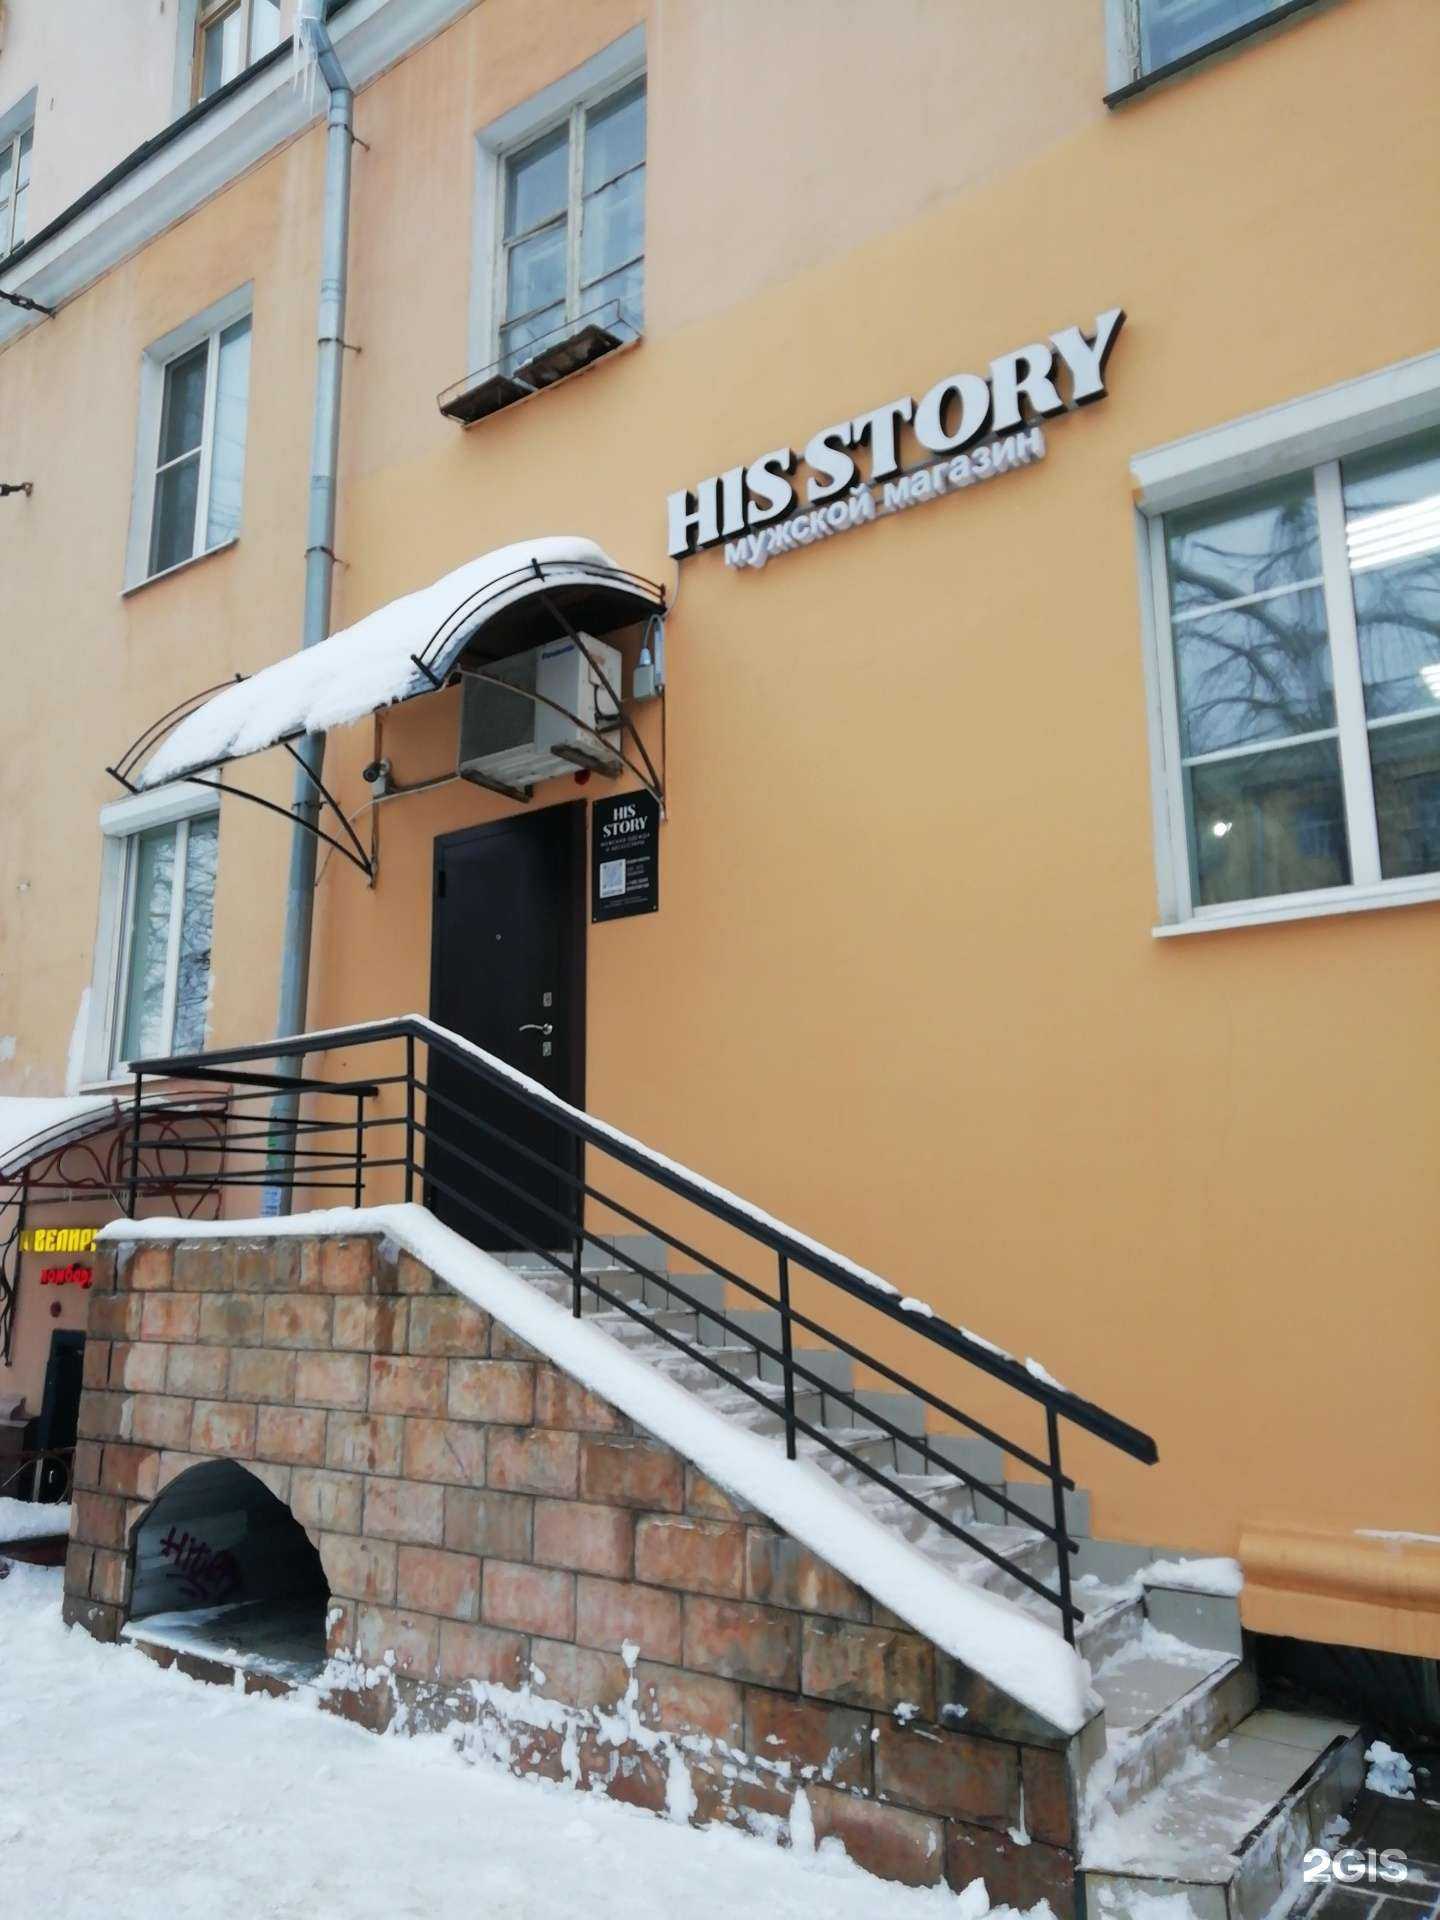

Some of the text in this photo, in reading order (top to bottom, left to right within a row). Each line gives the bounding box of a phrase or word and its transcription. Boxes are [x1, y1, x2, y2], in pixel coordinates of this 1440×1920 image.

[667, 307, 1127, 560] HIS STORY
[724, 427, 1046, 569] мужской магазин
[602, 815, 648, 838] STORY
[613, 804, 637, 821] HIS
